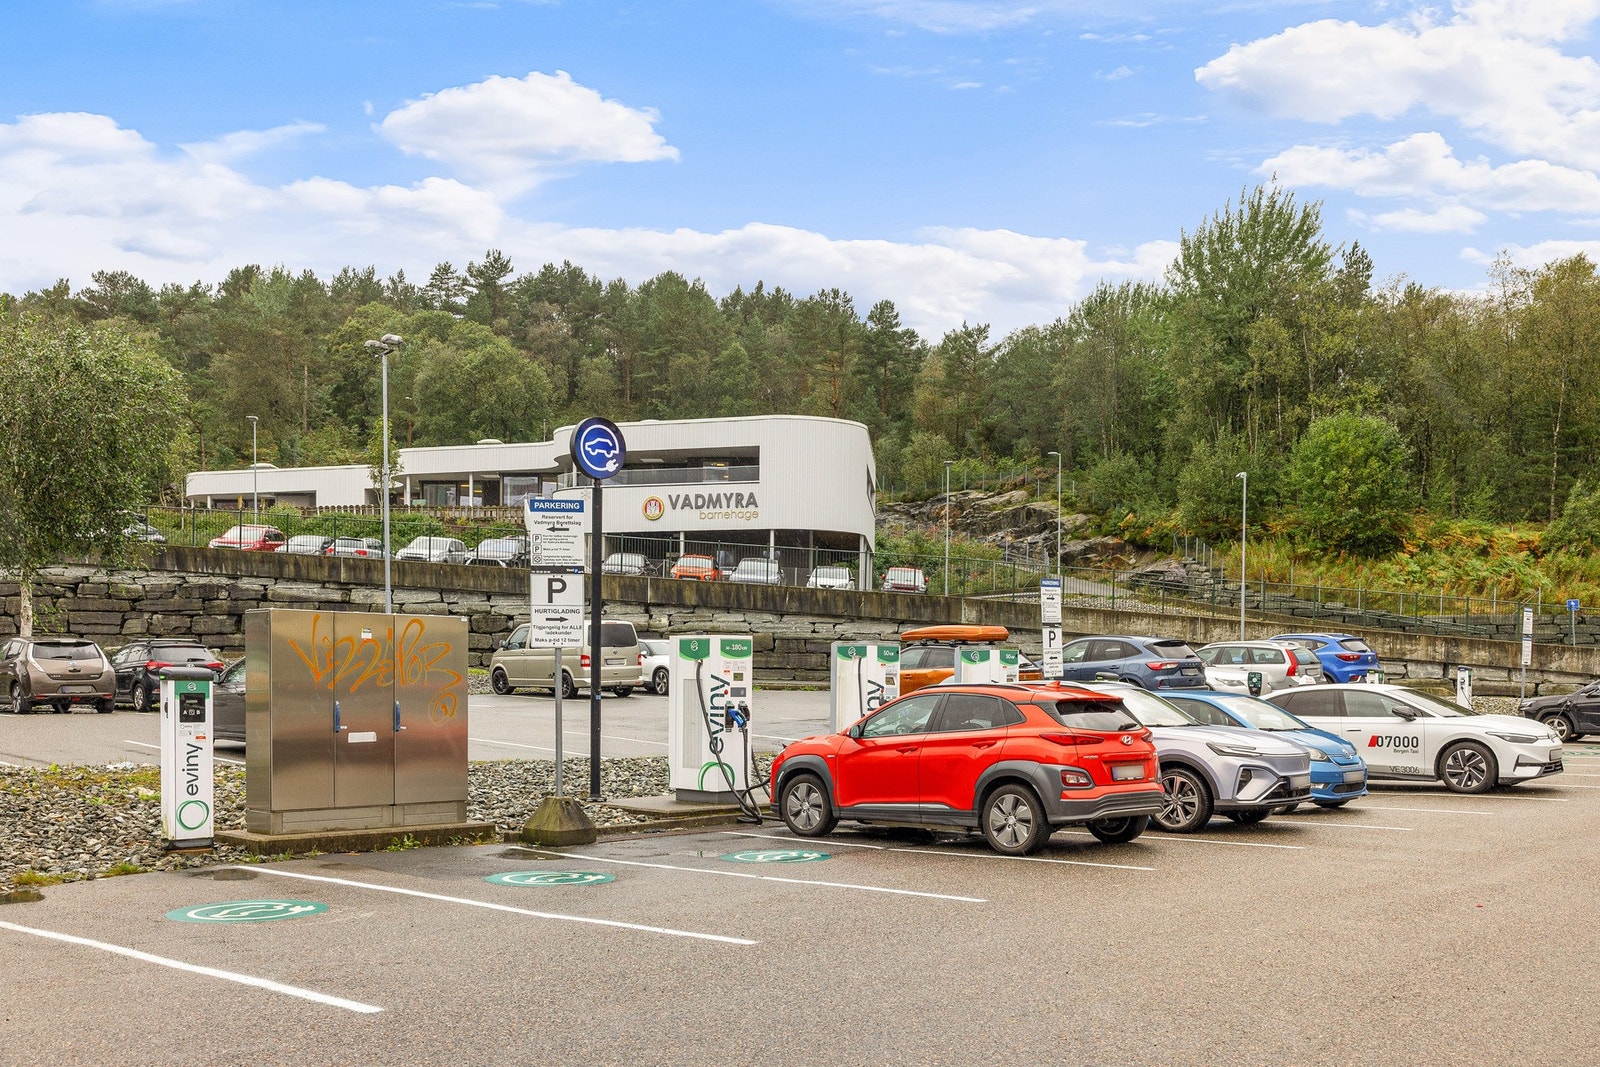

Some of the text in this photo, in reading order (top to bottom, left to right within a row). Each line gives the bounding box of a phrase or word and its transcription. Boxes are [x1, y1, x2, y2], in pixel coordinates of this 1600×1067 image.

[534, 502, 580, 510] PARKERING
[668, 492, 759, 510] VADMYRA
[699, 510, 759, 521] barnehage
[547, 578, 567, 604] P
[1049, 630, 1056, 647] P
[709, 674, 731, 755] eviny
[1377, 736, 1419, 748] 07000
[182, 742, 203, 796] eviny
